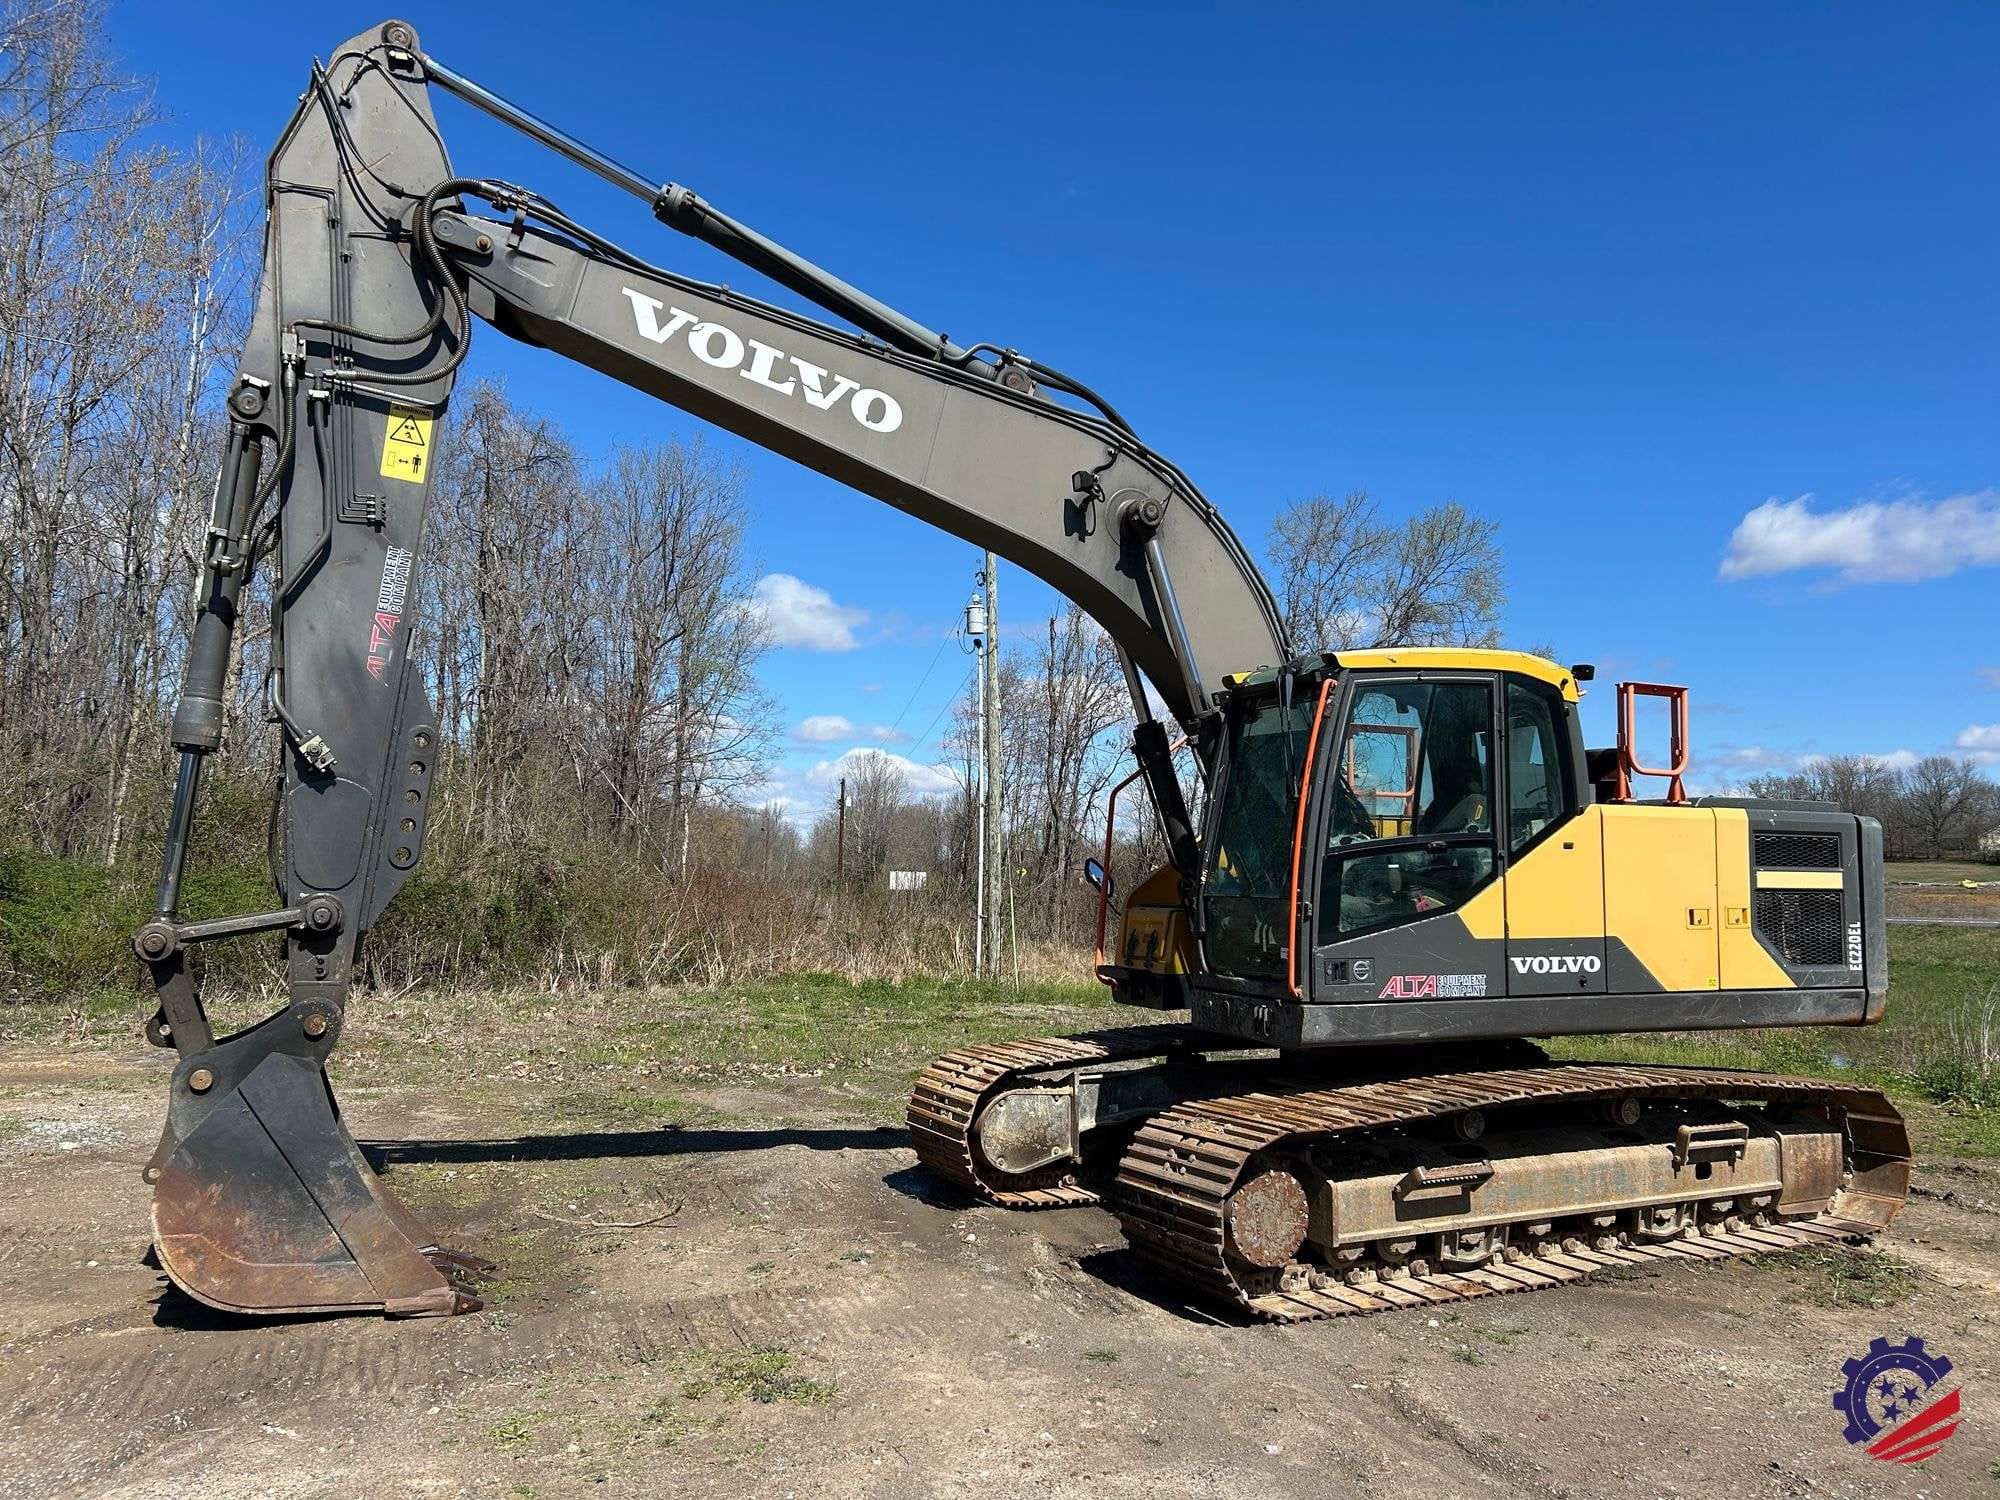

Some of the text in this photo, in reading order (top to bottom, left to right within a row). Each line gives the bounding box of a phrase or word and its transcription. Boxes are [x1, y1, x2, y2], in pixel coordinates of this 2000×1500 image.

[621, 286, 903, 433] VOLVO
[377, 545, 400, 612] EQUIPMENT
[390, 547, 413, 615] COMPANY
[1847, 921, 1863, 971] EC220EL
[1437, 974, 1487, 986] EQUIPMENT
[1510, 955, 1602, 975] VOLVO
[1378, 975, 1438, 998] ALTA
[1437, 985, 1487, 998] COMPANY
